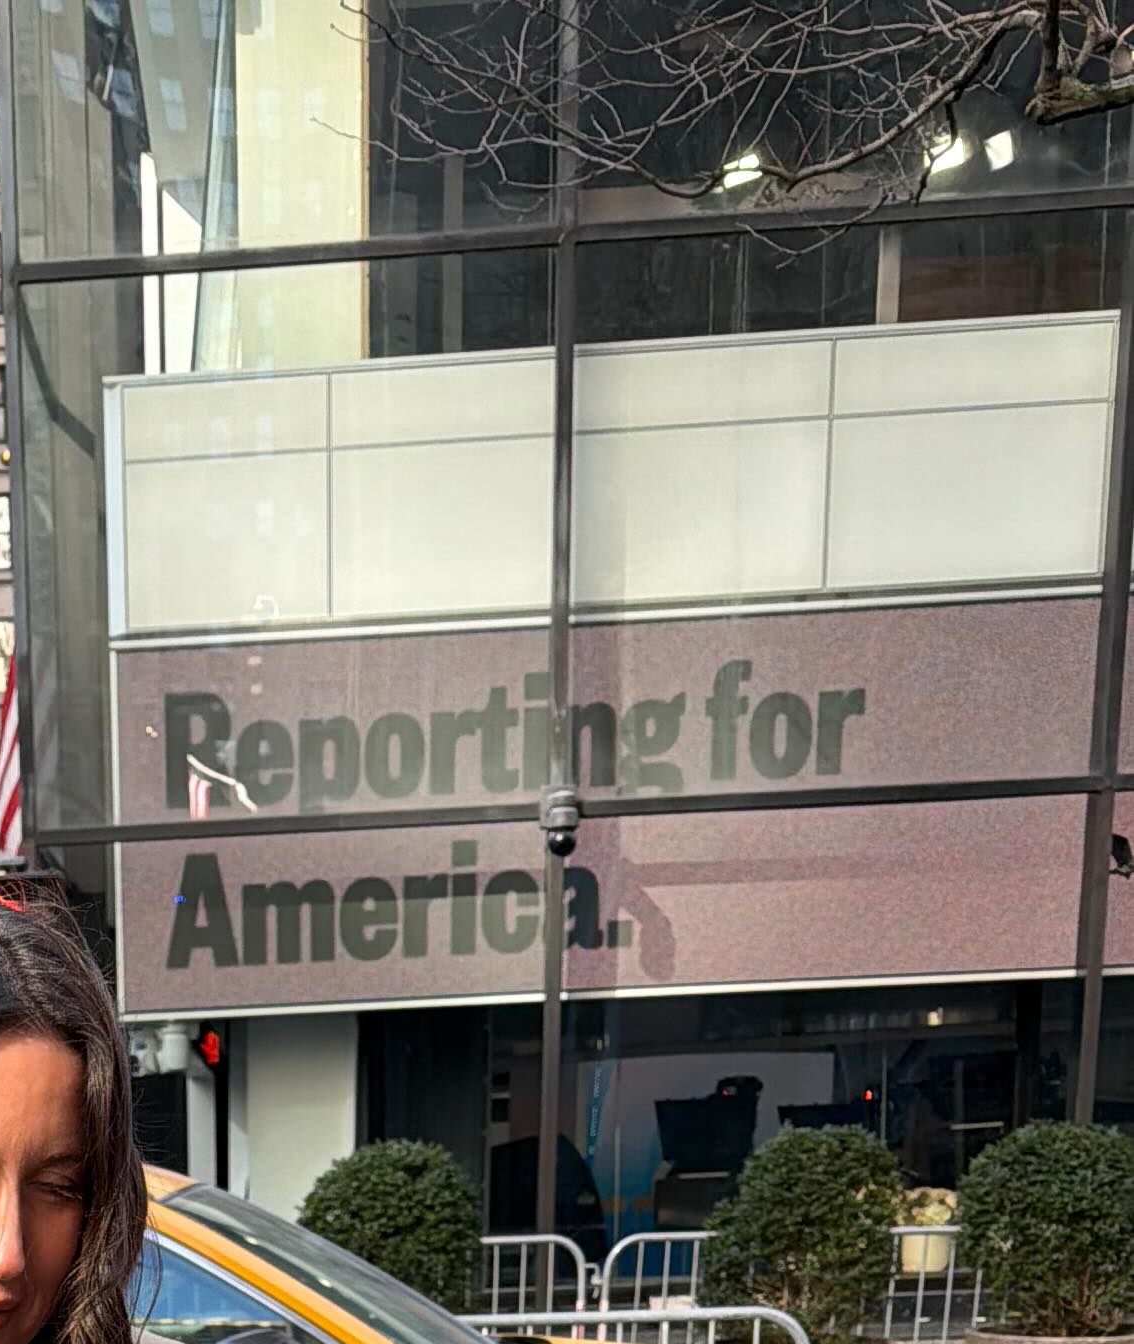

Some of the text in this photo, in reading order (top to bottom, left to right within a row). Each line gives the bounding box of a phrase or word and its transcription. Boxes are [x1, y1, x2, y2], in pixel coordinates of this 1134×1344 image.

[167, 659, 865, 812] Reporting for
[166, 840, 633, 968] America.
